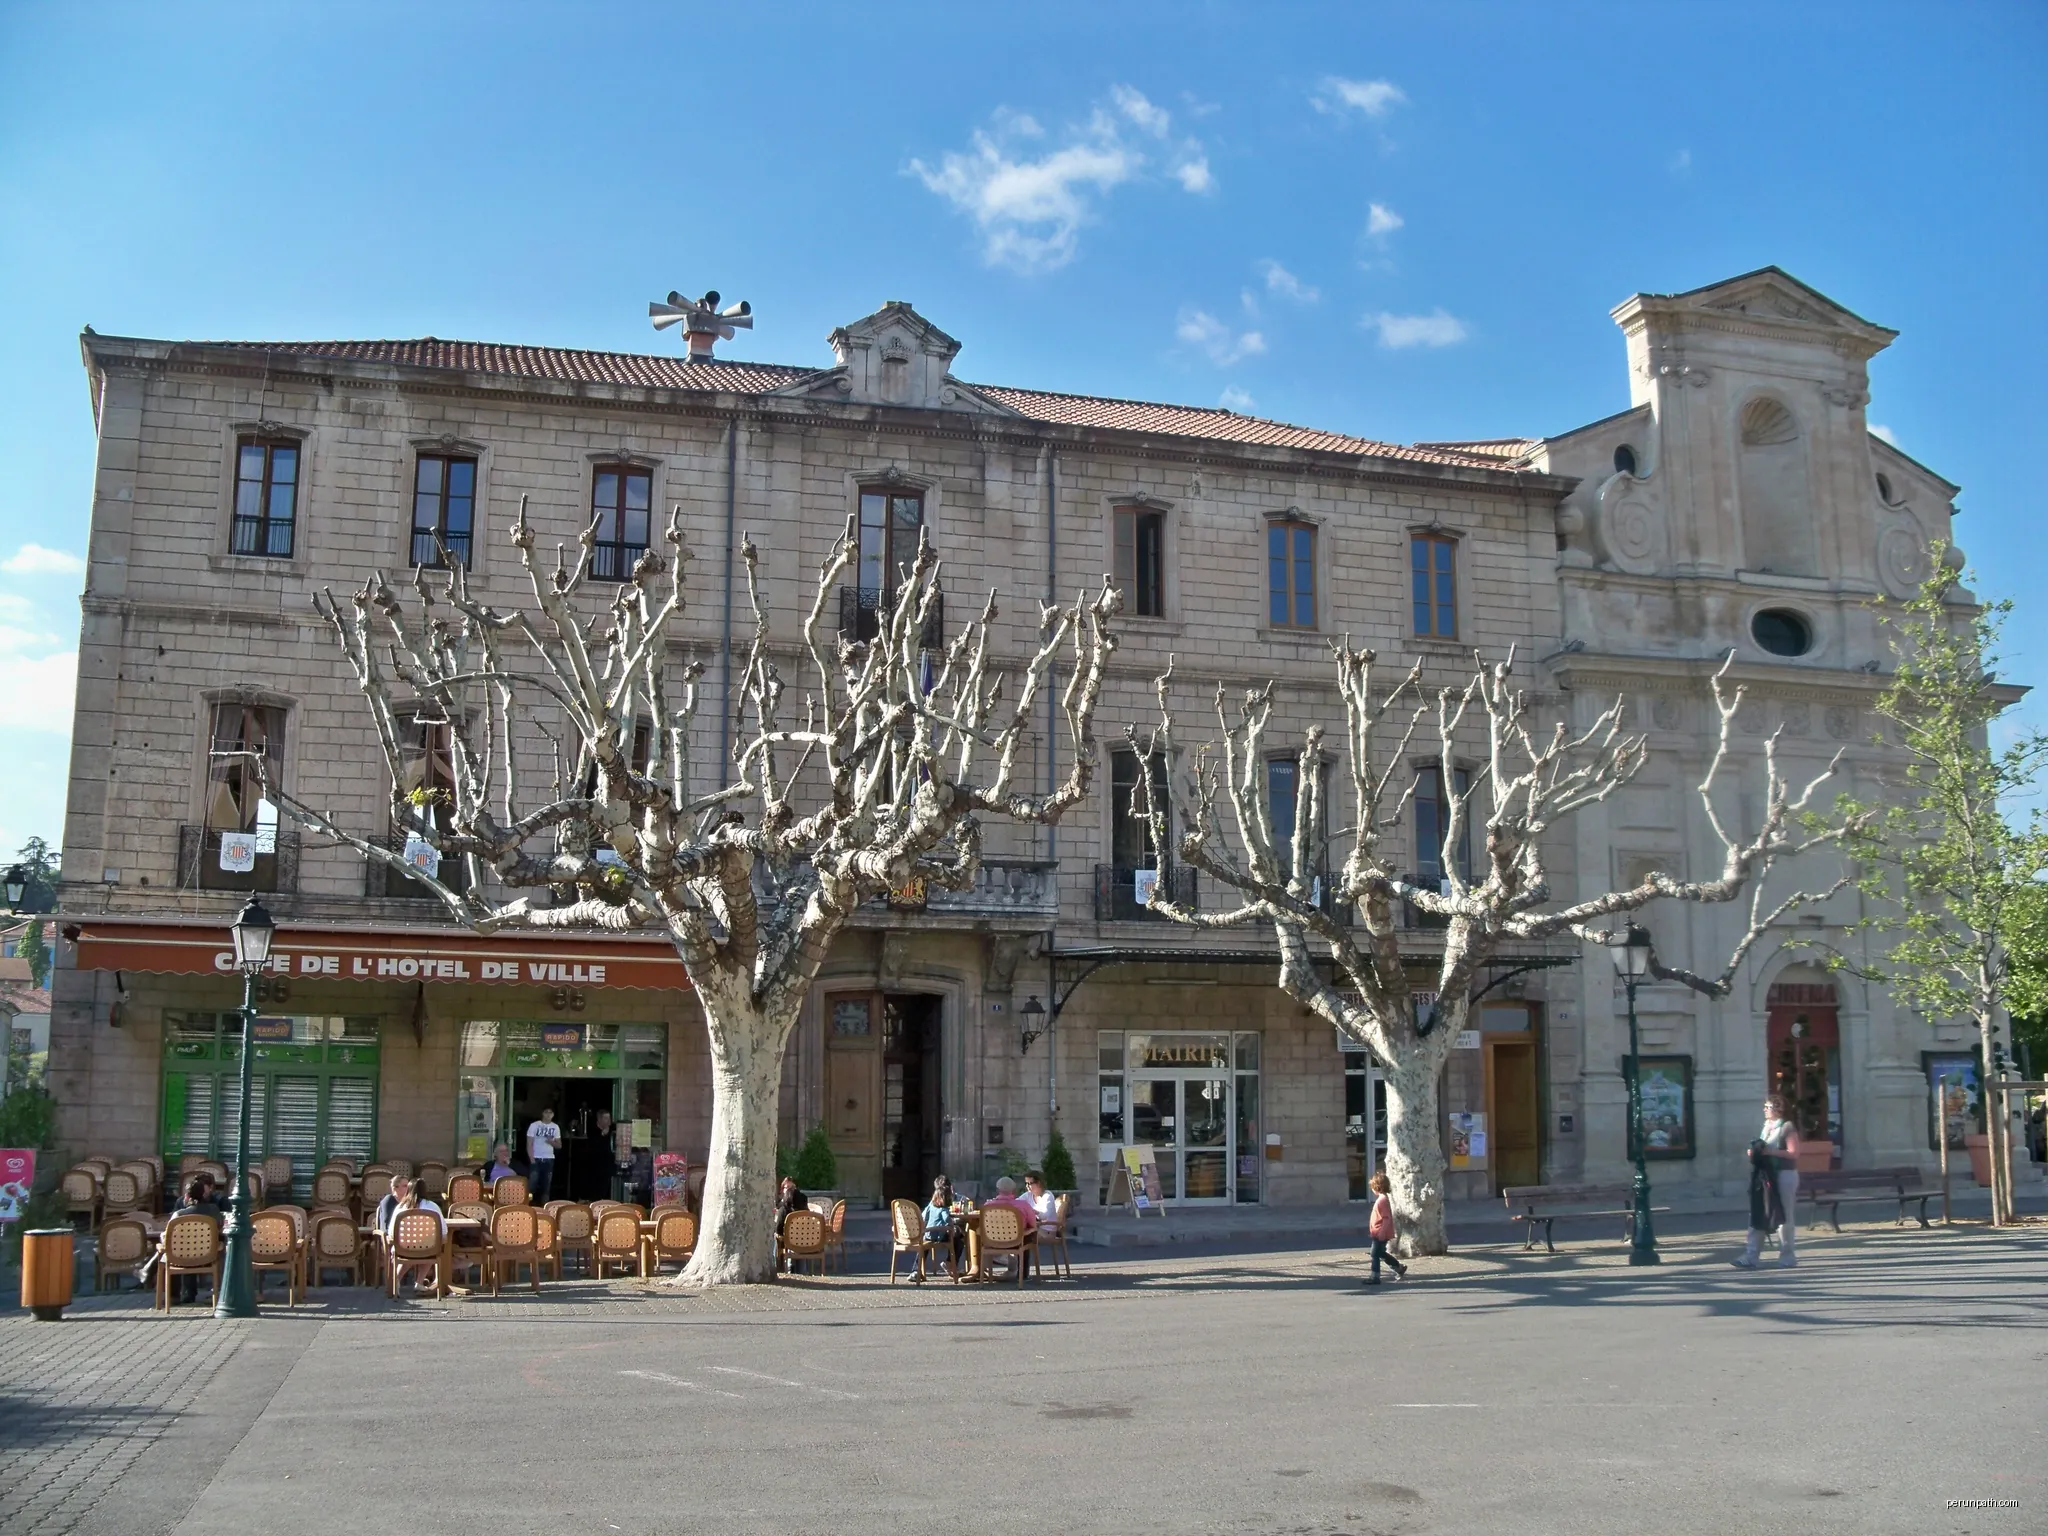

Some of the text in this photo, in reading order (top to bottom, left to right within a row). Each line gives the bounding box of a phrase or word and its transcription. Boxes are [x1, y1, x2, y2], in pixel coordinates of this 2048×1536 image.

[301, 955, 339, 974] DE
[481, 961, 519, 980] DE
[528, 963, 606, 983] VILLE
